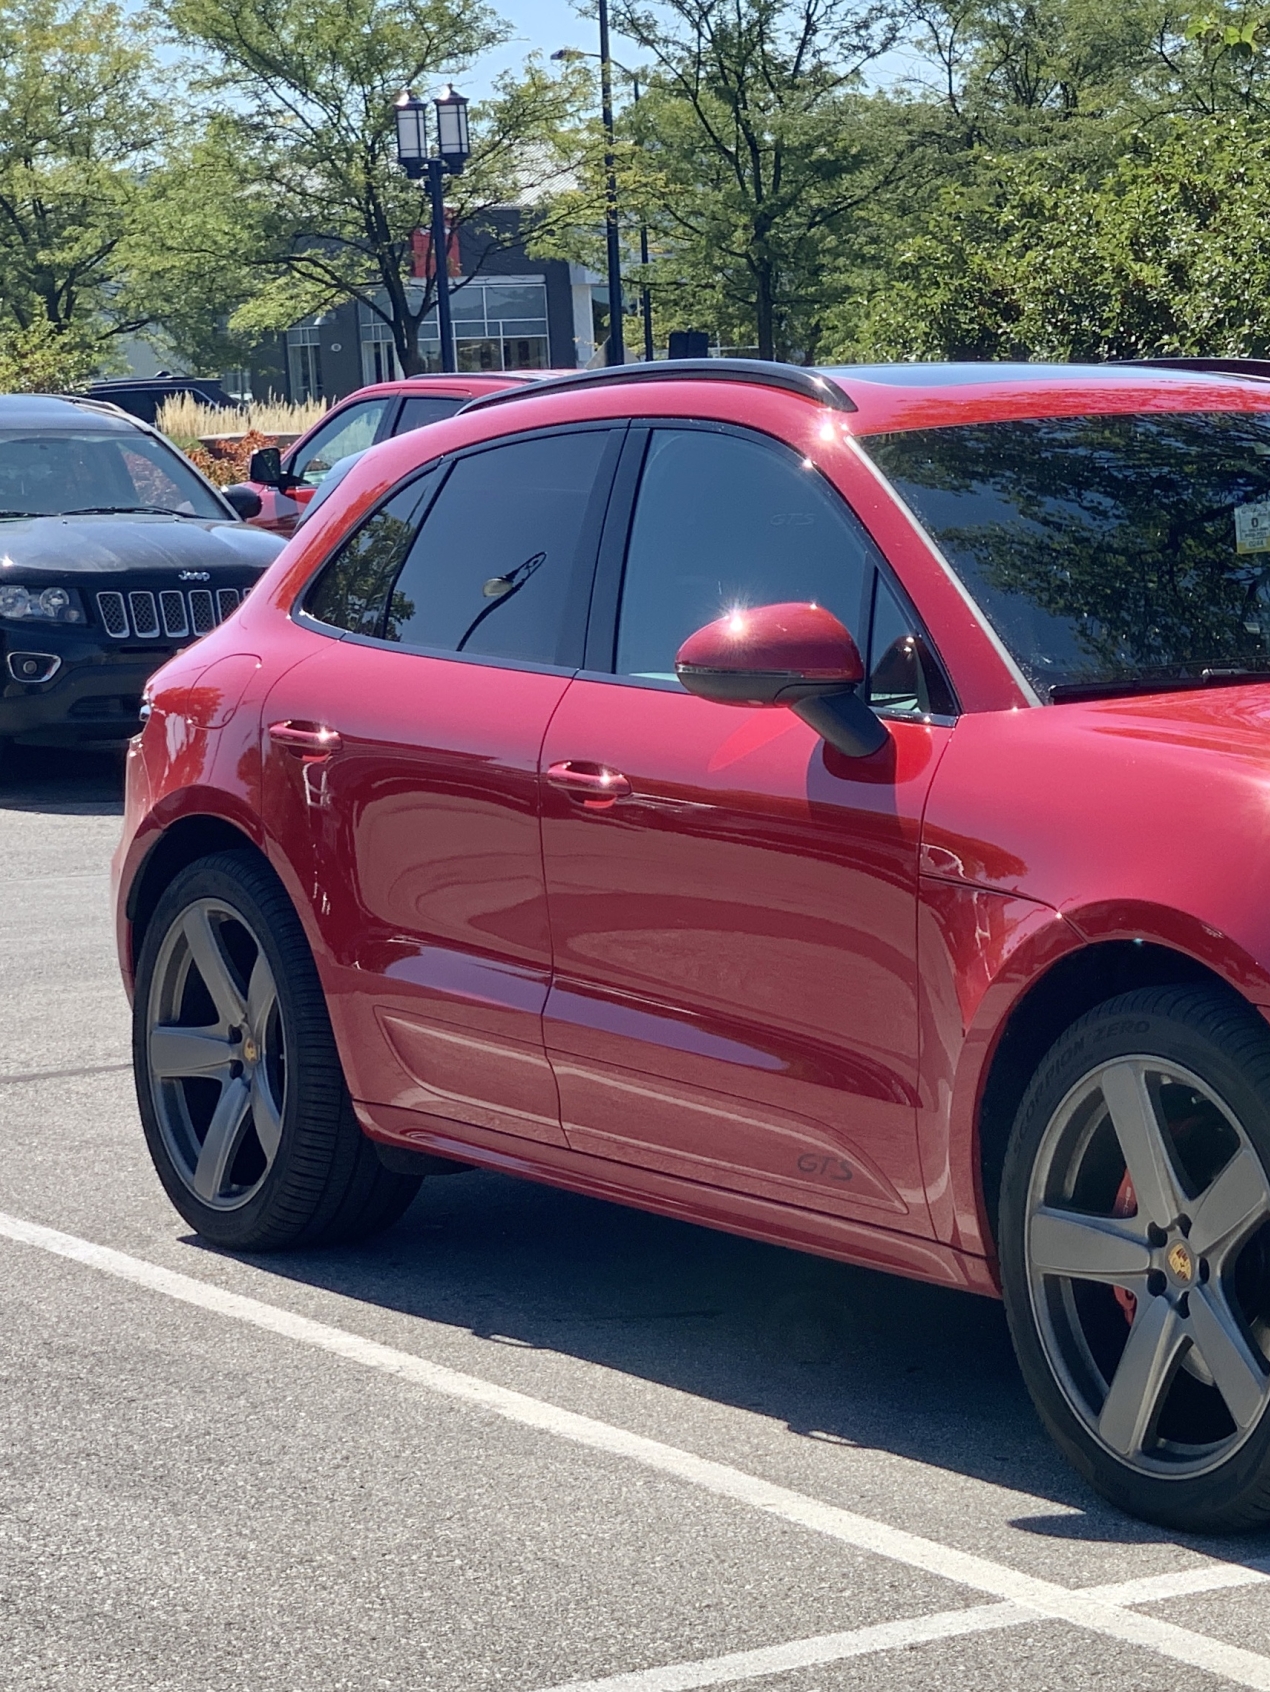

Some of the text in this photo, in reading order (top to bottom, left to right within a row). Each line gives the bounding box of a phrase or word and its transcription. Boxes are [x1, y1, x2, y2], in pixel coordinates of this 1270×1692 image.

[770, 513, 817, 526] GTS
[178, 570, 210, 581] Jeep
[1093, 1020, 1152, 1043] ZERO
[797, 1153, 853, 1181] GTS
